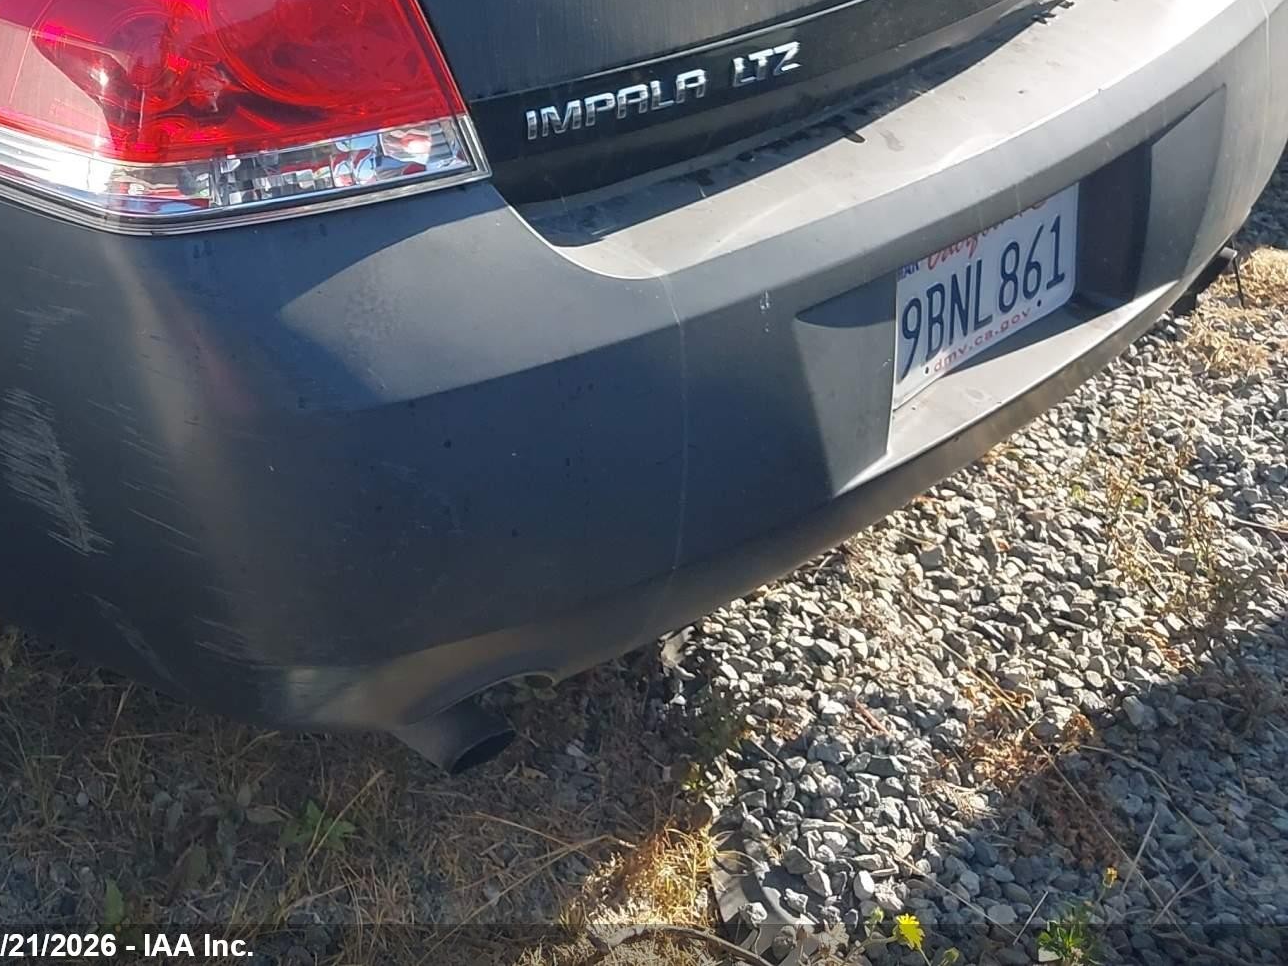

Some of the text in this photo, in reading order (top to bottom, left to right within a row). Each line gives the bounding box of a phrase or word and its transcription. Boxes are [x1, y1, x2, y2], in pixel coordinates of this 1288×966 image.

[525, 41, 801, 140] IMPALA LTZ
[933, 307, 1031, 373] dmv.ca.gov
